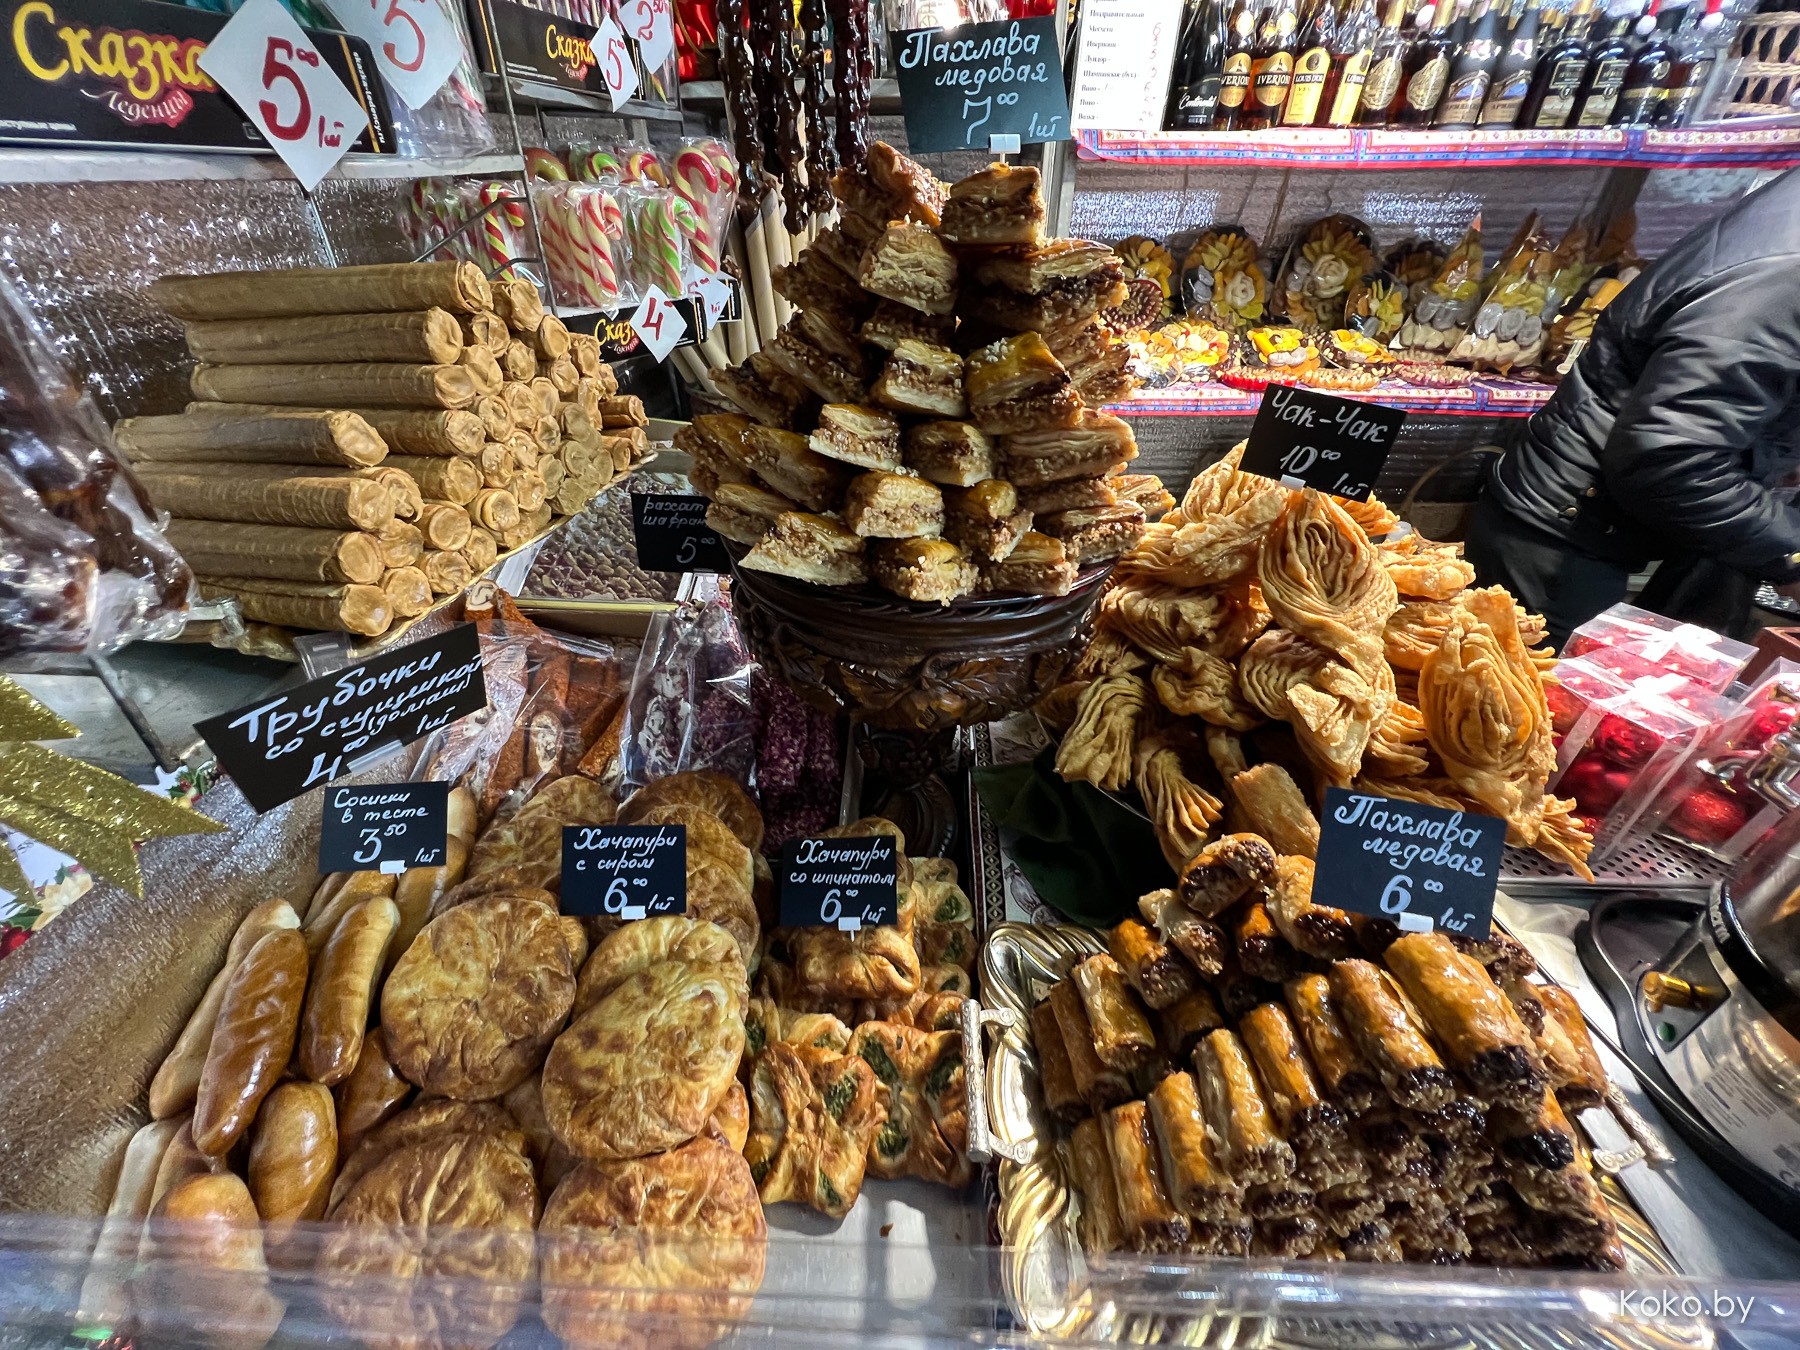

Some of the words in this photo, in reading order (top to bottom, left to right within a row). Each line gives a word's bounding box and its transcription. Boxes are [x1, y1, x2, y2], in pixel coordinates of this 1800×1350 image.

[899, 21, 1041, 69] Пахлава
[935, 56, 1049, 95] медовая
[1271, 389, 1388, 442] Чак-Чак
[228, 651, 442, 747] Трубочки
[265, 737, 304, 760] со
[334, 789, 411, 808] Сосиски
[341, 808, 353, 823] в
[364, 807, 429, 821] тесте
[1334, 795, 1482, 849] Пахлава
[573, 826, 677, 857] Хачапури
[796, 838, 890, 870] Хачапури
[1362, 837, 1486, 878] медовая
[576, 859, 586, 870] с
[597, 850, 655, 876] сыром
[790, 872, 807, 883] со
[812, 873, 895, 886] шпинатом
